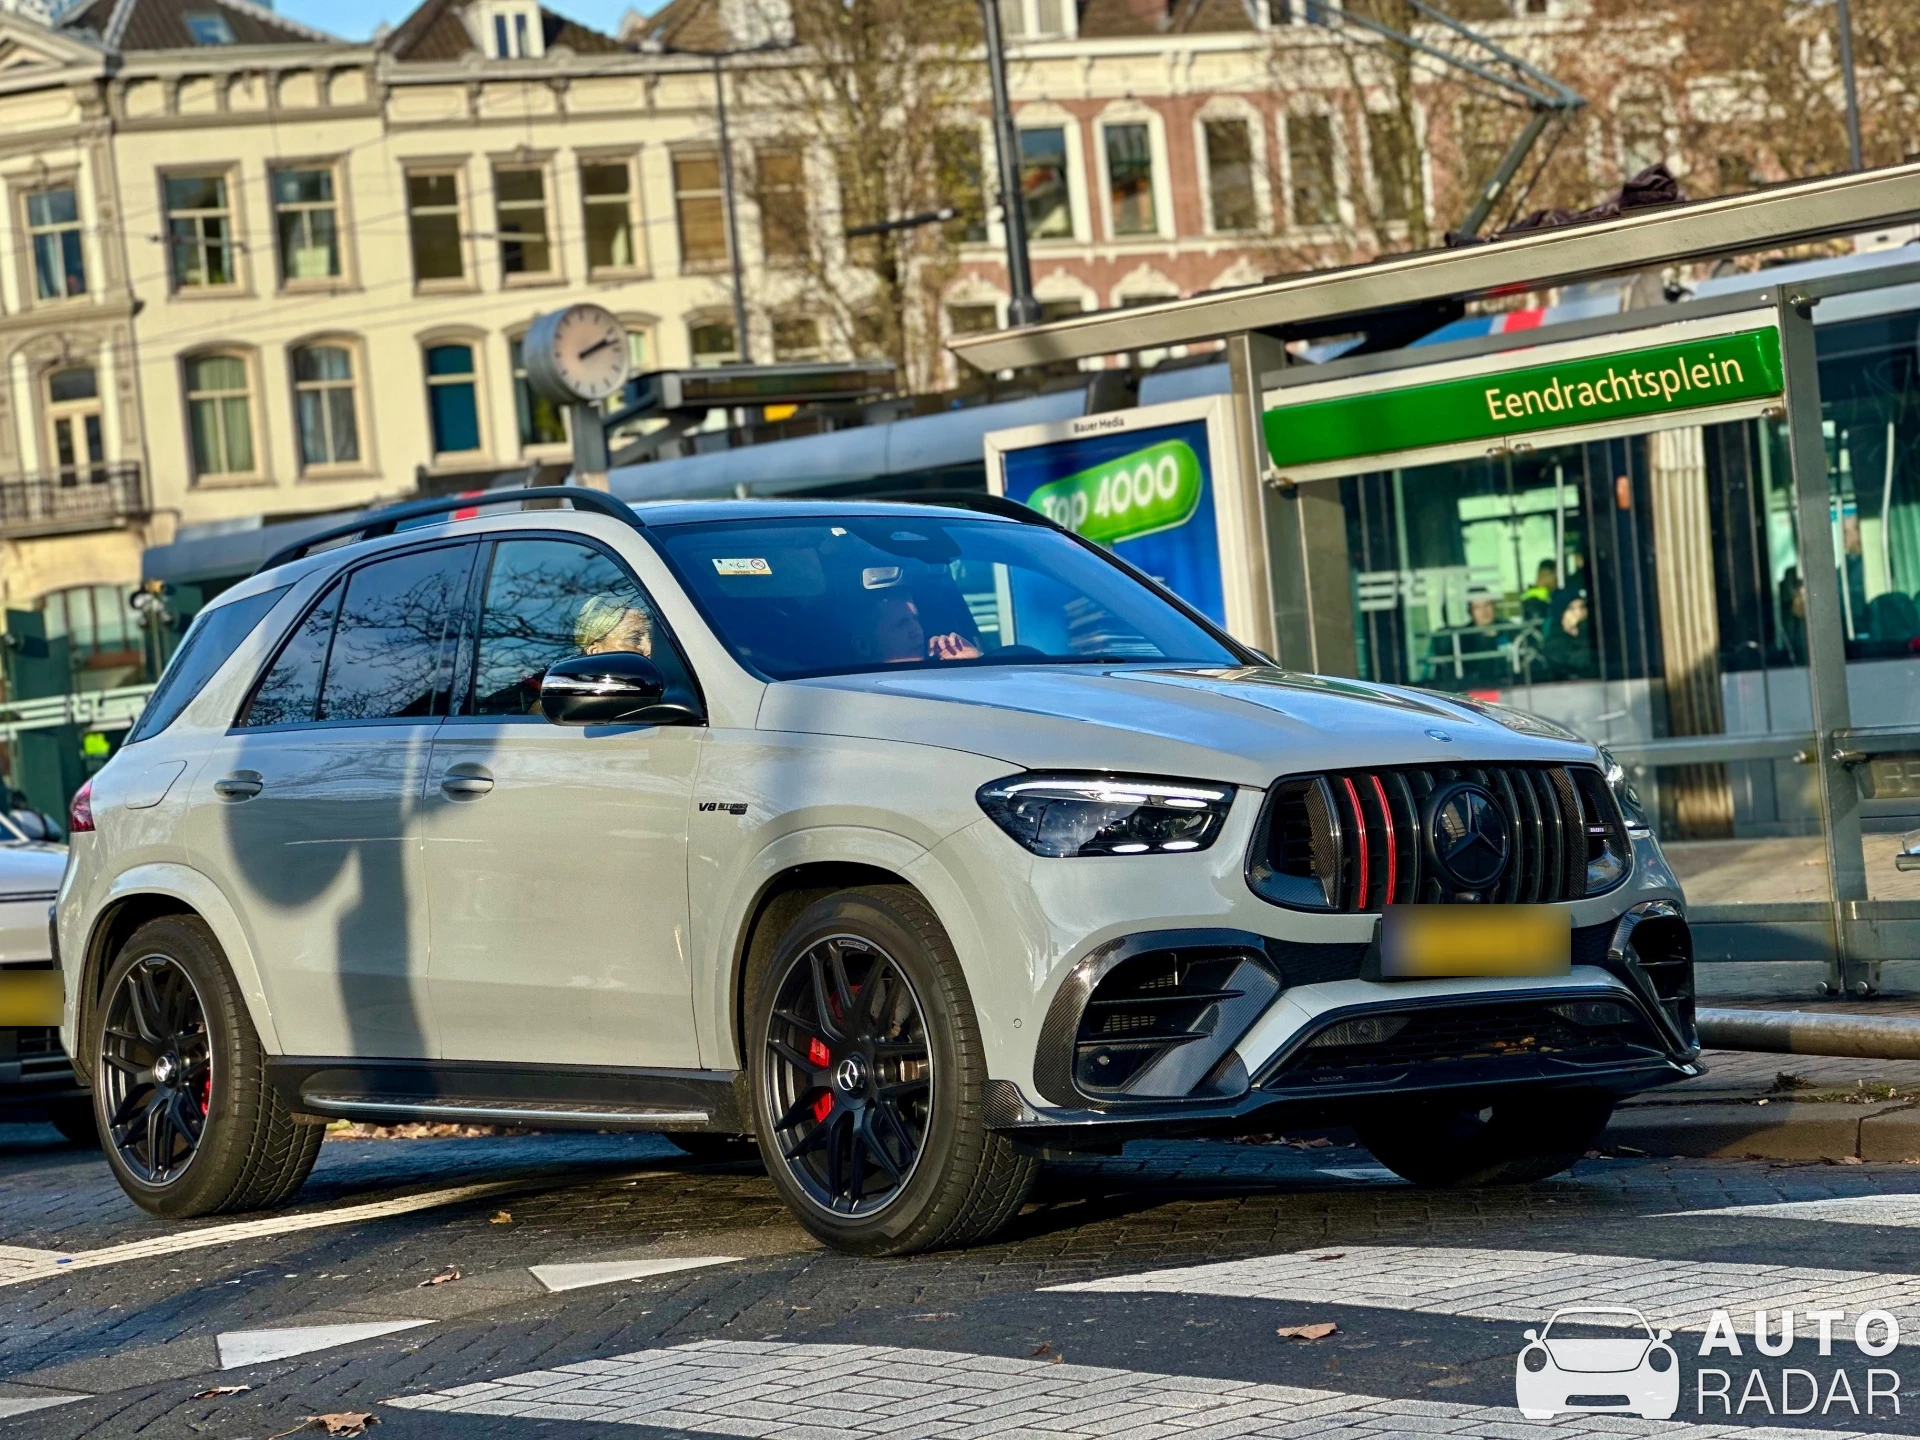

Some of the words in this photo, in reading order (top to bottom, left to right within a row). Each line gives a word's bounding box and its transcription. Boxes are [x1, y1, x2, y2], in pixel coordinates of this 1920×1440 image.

[1485, 353, 1744, 420] Eendrachtsplein
[1074, 422, 1097, 433] Bauer
[1099, 416, 1125, 428] Media
[1094, 455, 1178, 517] 4000
[699, 802, 717, 811] V8
